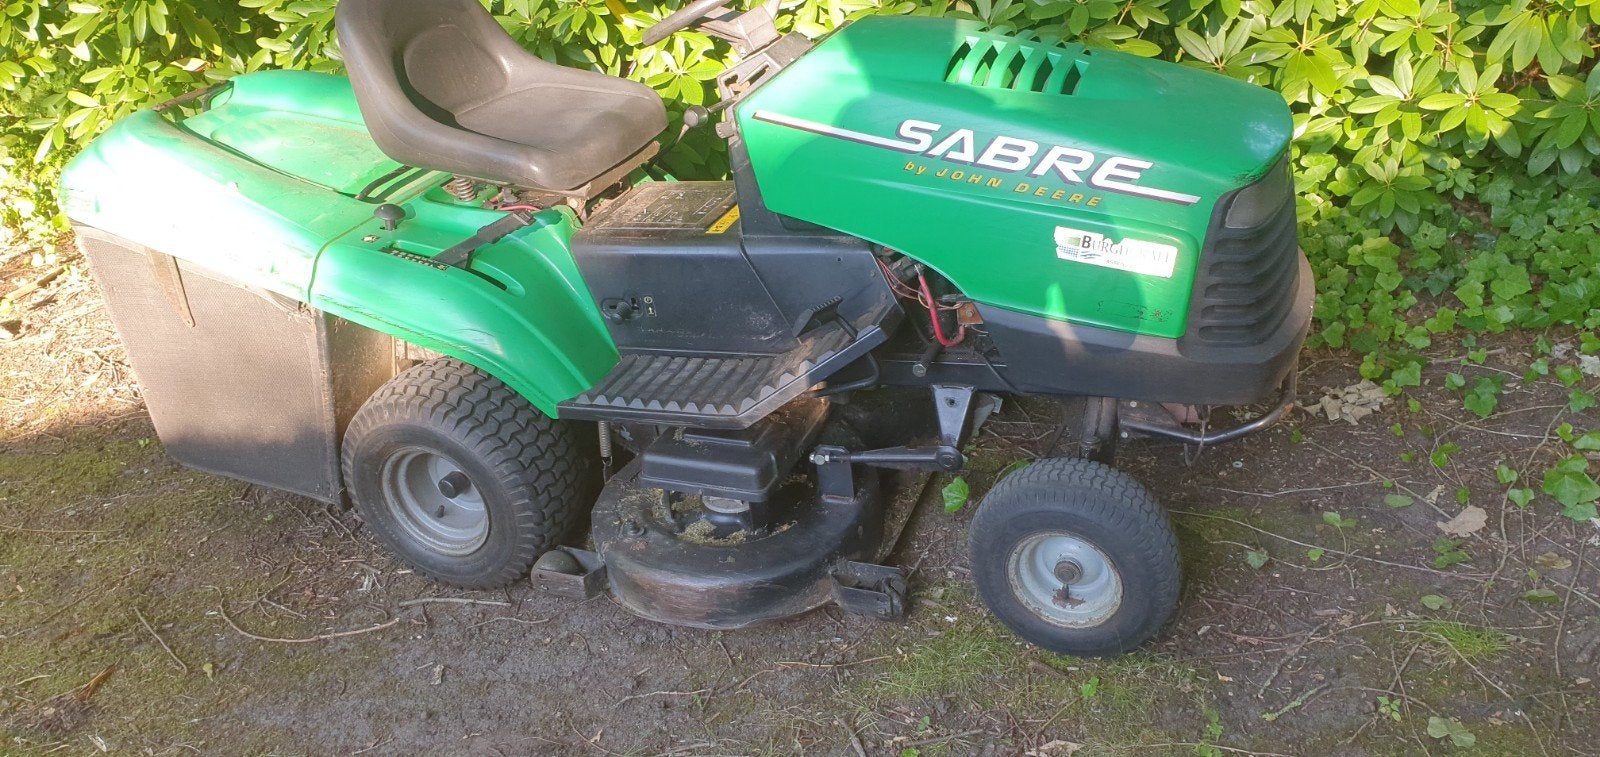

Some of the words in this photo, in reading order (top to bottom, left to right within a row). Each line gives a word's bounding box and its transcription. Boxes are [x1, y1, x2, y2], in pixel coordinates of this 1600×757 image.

[896, 118, 1157, 190] SABRE
[903, 160, 927, 176] by
[934, 167, 1001, 189] JOHN
[1013, 182, 1103, 208] DEERE
